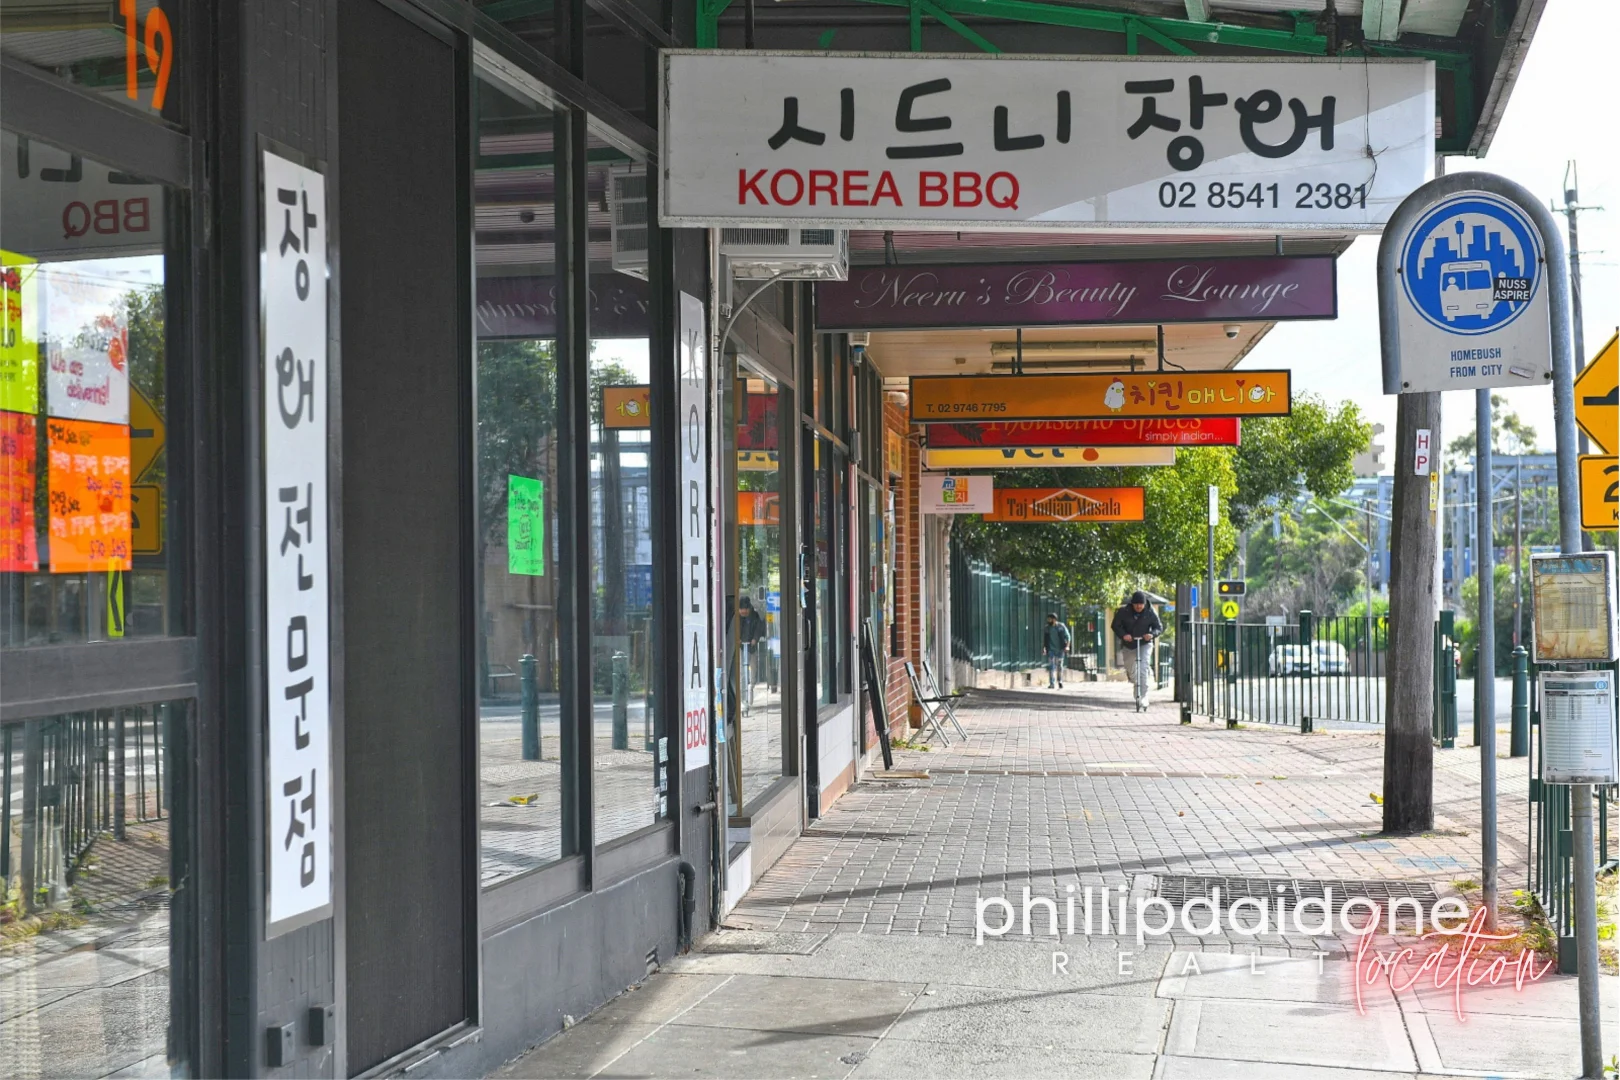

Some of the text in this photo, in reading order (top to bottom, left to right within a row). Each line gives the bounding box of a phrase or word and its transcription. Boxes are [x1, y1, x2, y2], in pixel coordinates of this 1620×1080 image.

[120, 0, 173, 111] 19
[768, 75, 1337, 171] 시드니 장어
[738, 168, 1021, 211] KOREA BBQ
[1158, 181, 1367, 209] 02 8541 2381
[1004, 268, 1140, 317] Beauty
[1160, 264, 1300, 315] Lounge
[1494, 290, 1530, 301] ASPIRE
[1498, 279, 1527, 290] NUSS
[1450, 347, 1502, 362] HOMEBUSH
[1450, 364, 1503, 378] FROM CITY
[926, 403, 1007, 413] T. 02 9746 7795
[1145, 431, 1178, 442] simply
[688, 328, 702, 689] KOREA
[1006, 498, 1121, 519] Taj Indian Masala
[686, 707, 708, 750] BBQ
